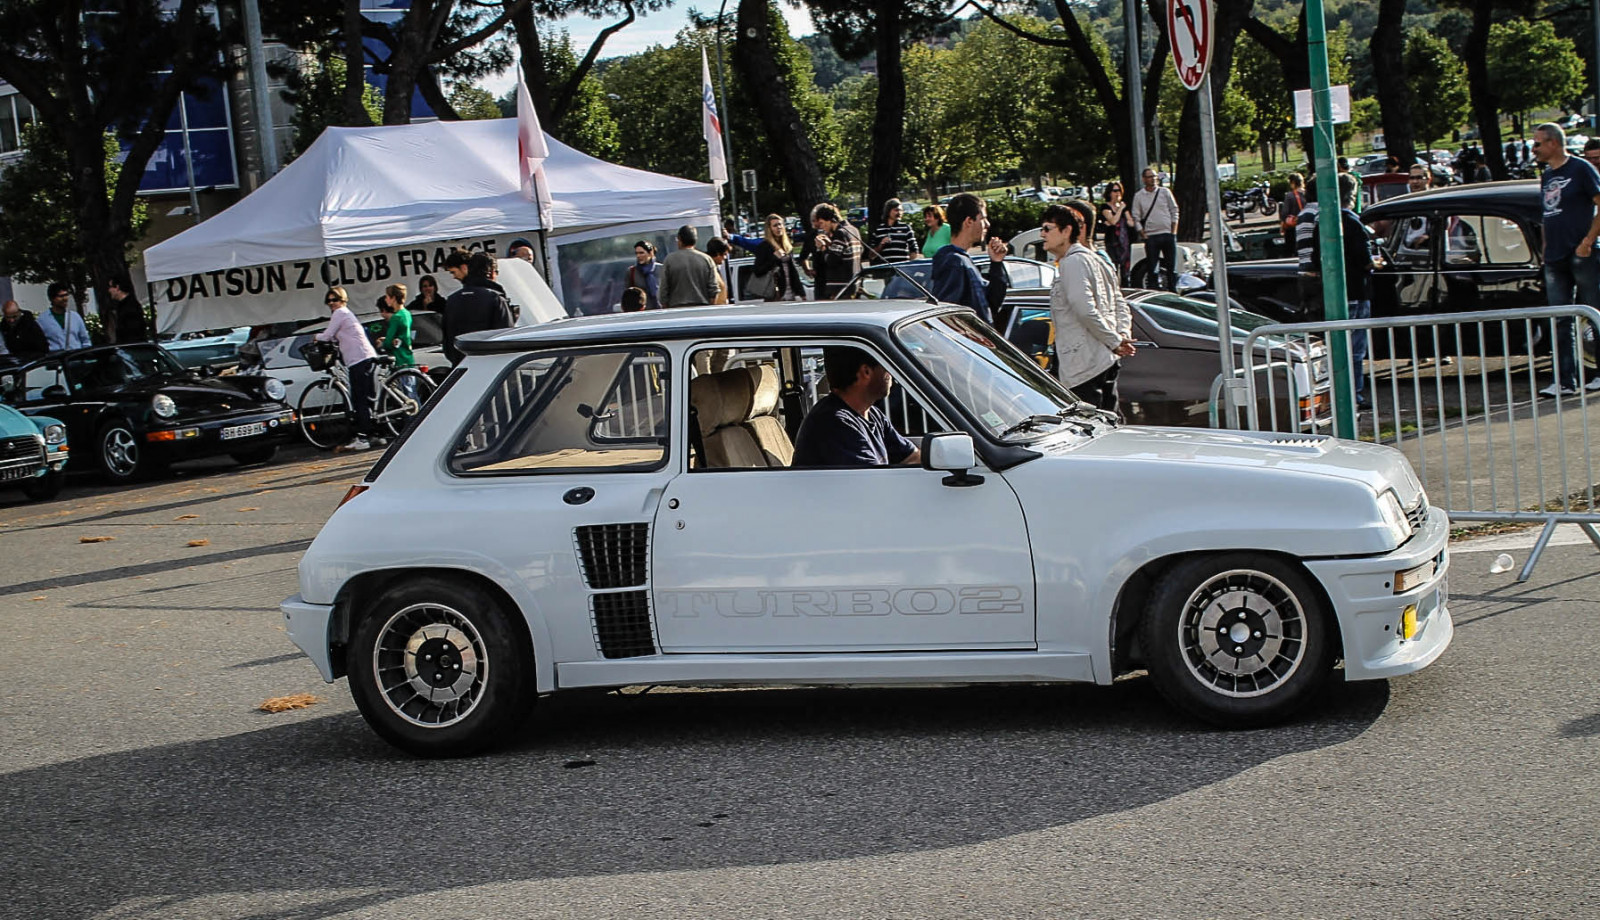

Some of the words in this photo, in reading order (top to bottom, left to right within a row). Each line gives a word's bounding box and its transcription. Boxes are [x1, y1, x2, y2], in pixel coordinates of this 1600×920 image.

[166, 265, 287, 303] DATSUN
[294, 261, 315, 289] Z
[320, 253, 392, 287] CLUB
[397, 239, 497, 277] FRAE
[657, 585, 1025, 618] TURBO2
